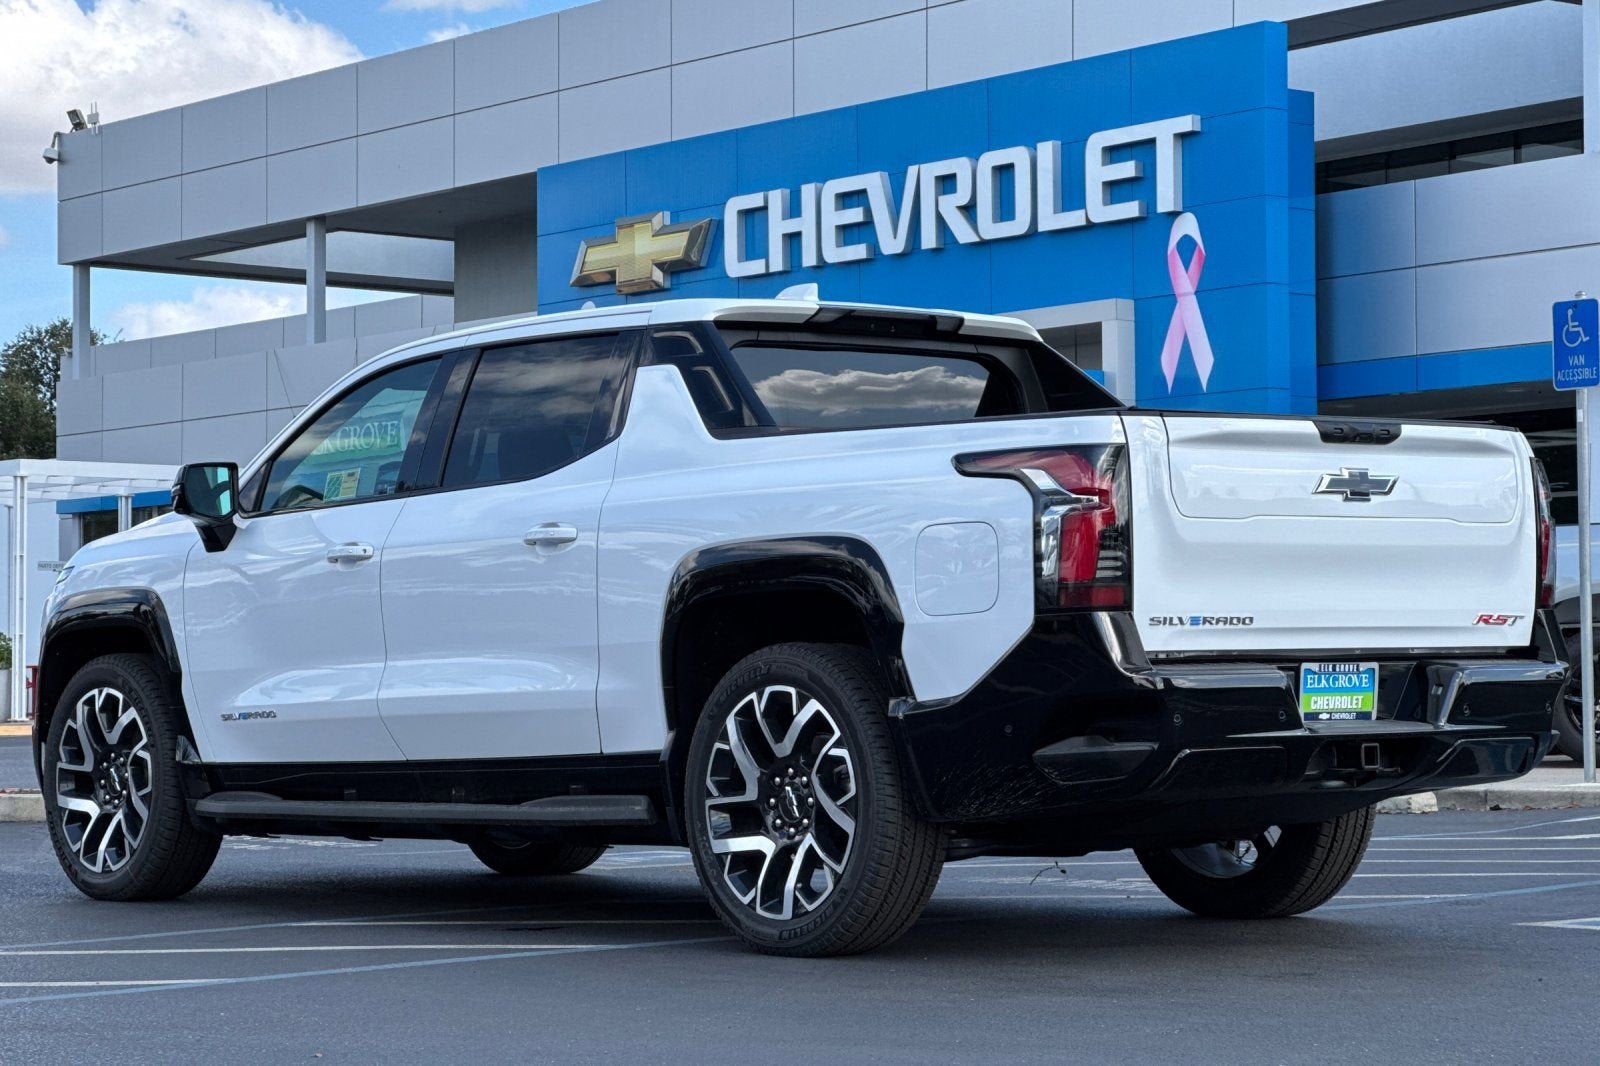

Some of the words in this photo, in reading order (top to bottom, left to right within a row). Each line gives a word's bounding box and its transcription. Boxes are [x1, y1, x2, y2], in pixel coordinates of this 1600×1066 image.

[724, 114, 1201, 278] CHEVROLET
[1568, 354, 1585, 366] VAN
[1557, 367, 1598, 381] ACCESSIBLE
[336, 420, 399, 452] GROVE
[1148, 616, 1254, 626] SILVERADO
[1472, 614, 1525, 626] RST
[1320, 664, 1333, 672] ELK
[1335, 664, 1357, 672] GROVE
[1306, 674, 1329, 689] ELK
[1329, 674, 1370, 688] GROVE
[1311, 695, 1364, 710] CHEVROLET
[220, 710, 277, 721] SILVERADO
[1331, 712, 1357, 720] CHEVROLET
